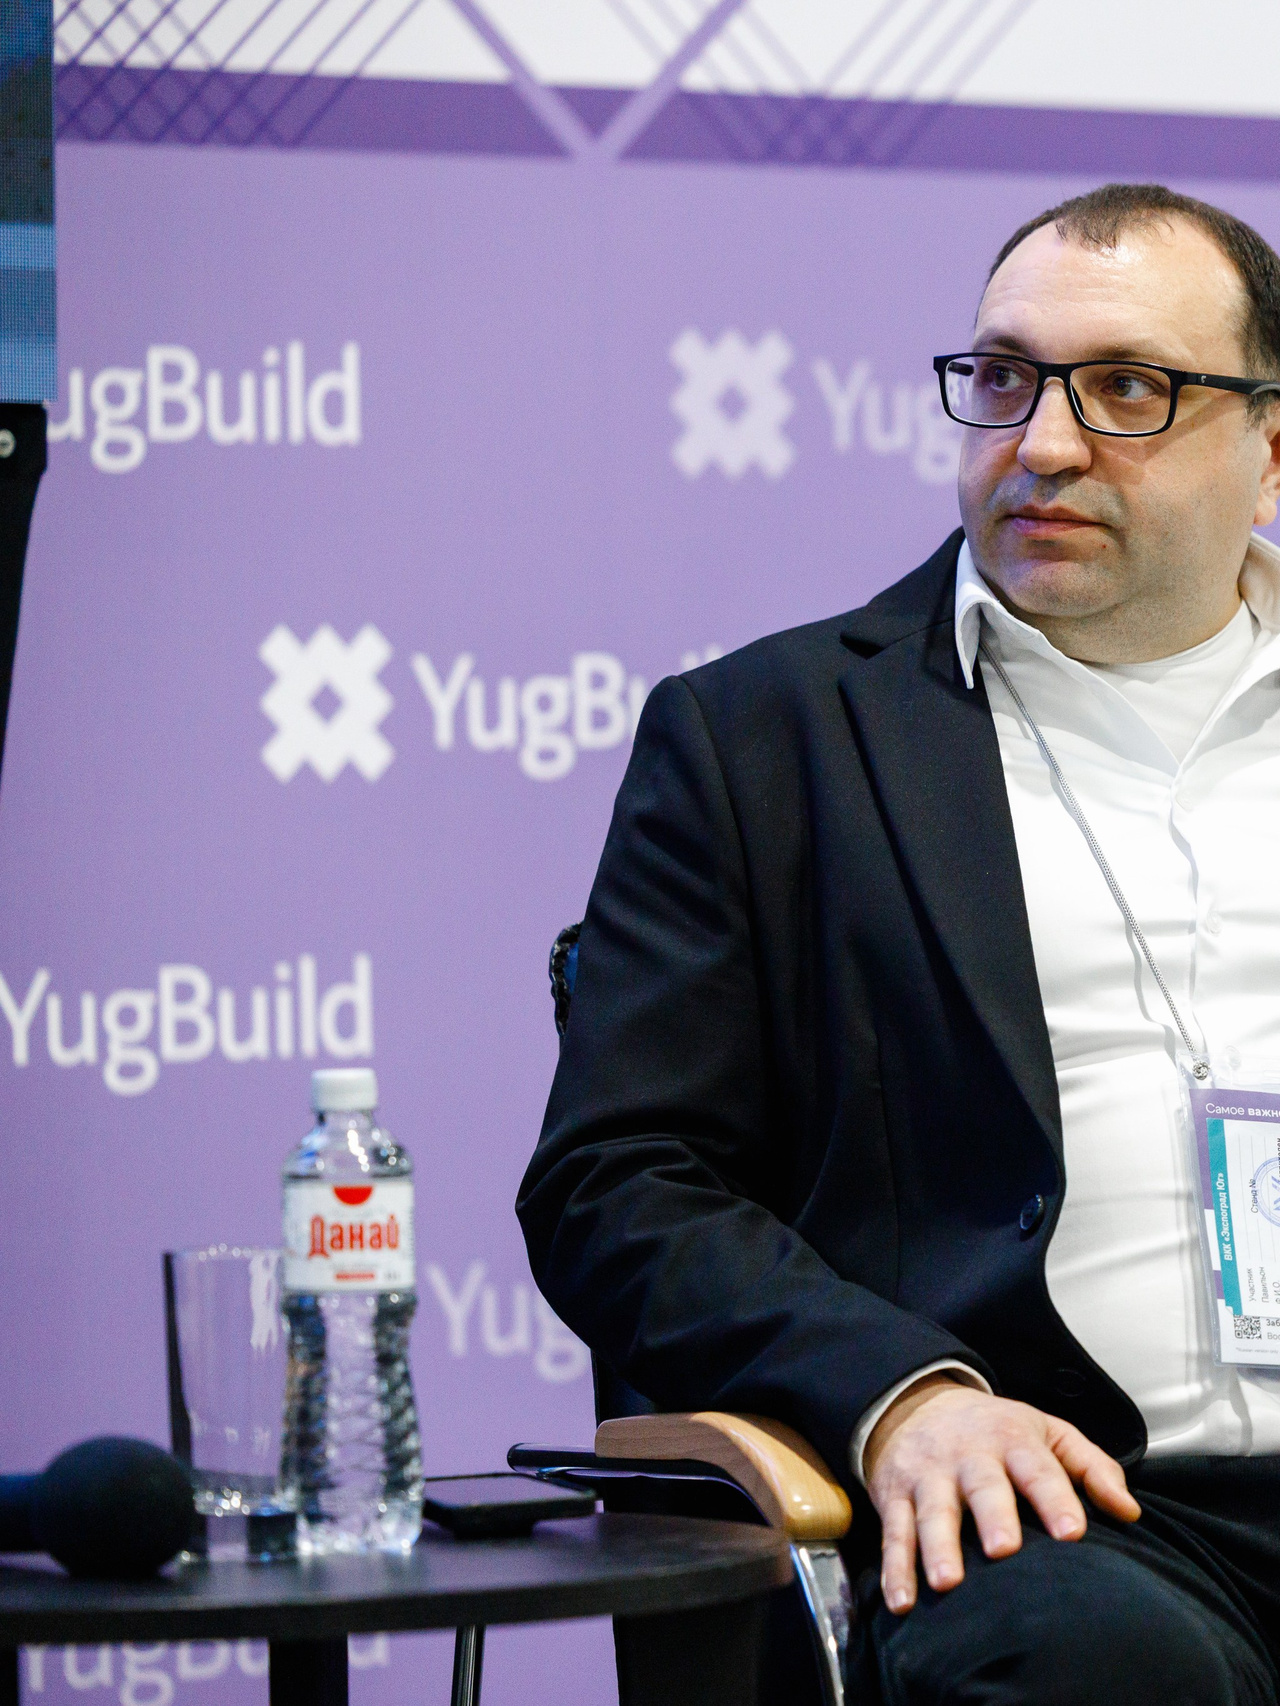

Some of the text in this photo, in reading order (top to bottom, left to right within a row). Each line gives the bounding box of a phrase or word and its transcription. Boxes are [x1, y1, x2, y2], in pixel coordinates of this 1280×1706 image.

[46, 342, 361, 473] ugBuild
[411, 645, 726, 782] YugB
[0, 952, 374, 1097] YugBuild
[1205, 1102, 1245, 1116] Самое
[1250, 1189, 1259, 1213] Стенд
[307, 1214, 400, 1260] Данай
[1259, 1266, 1270, 1304] Павильон
